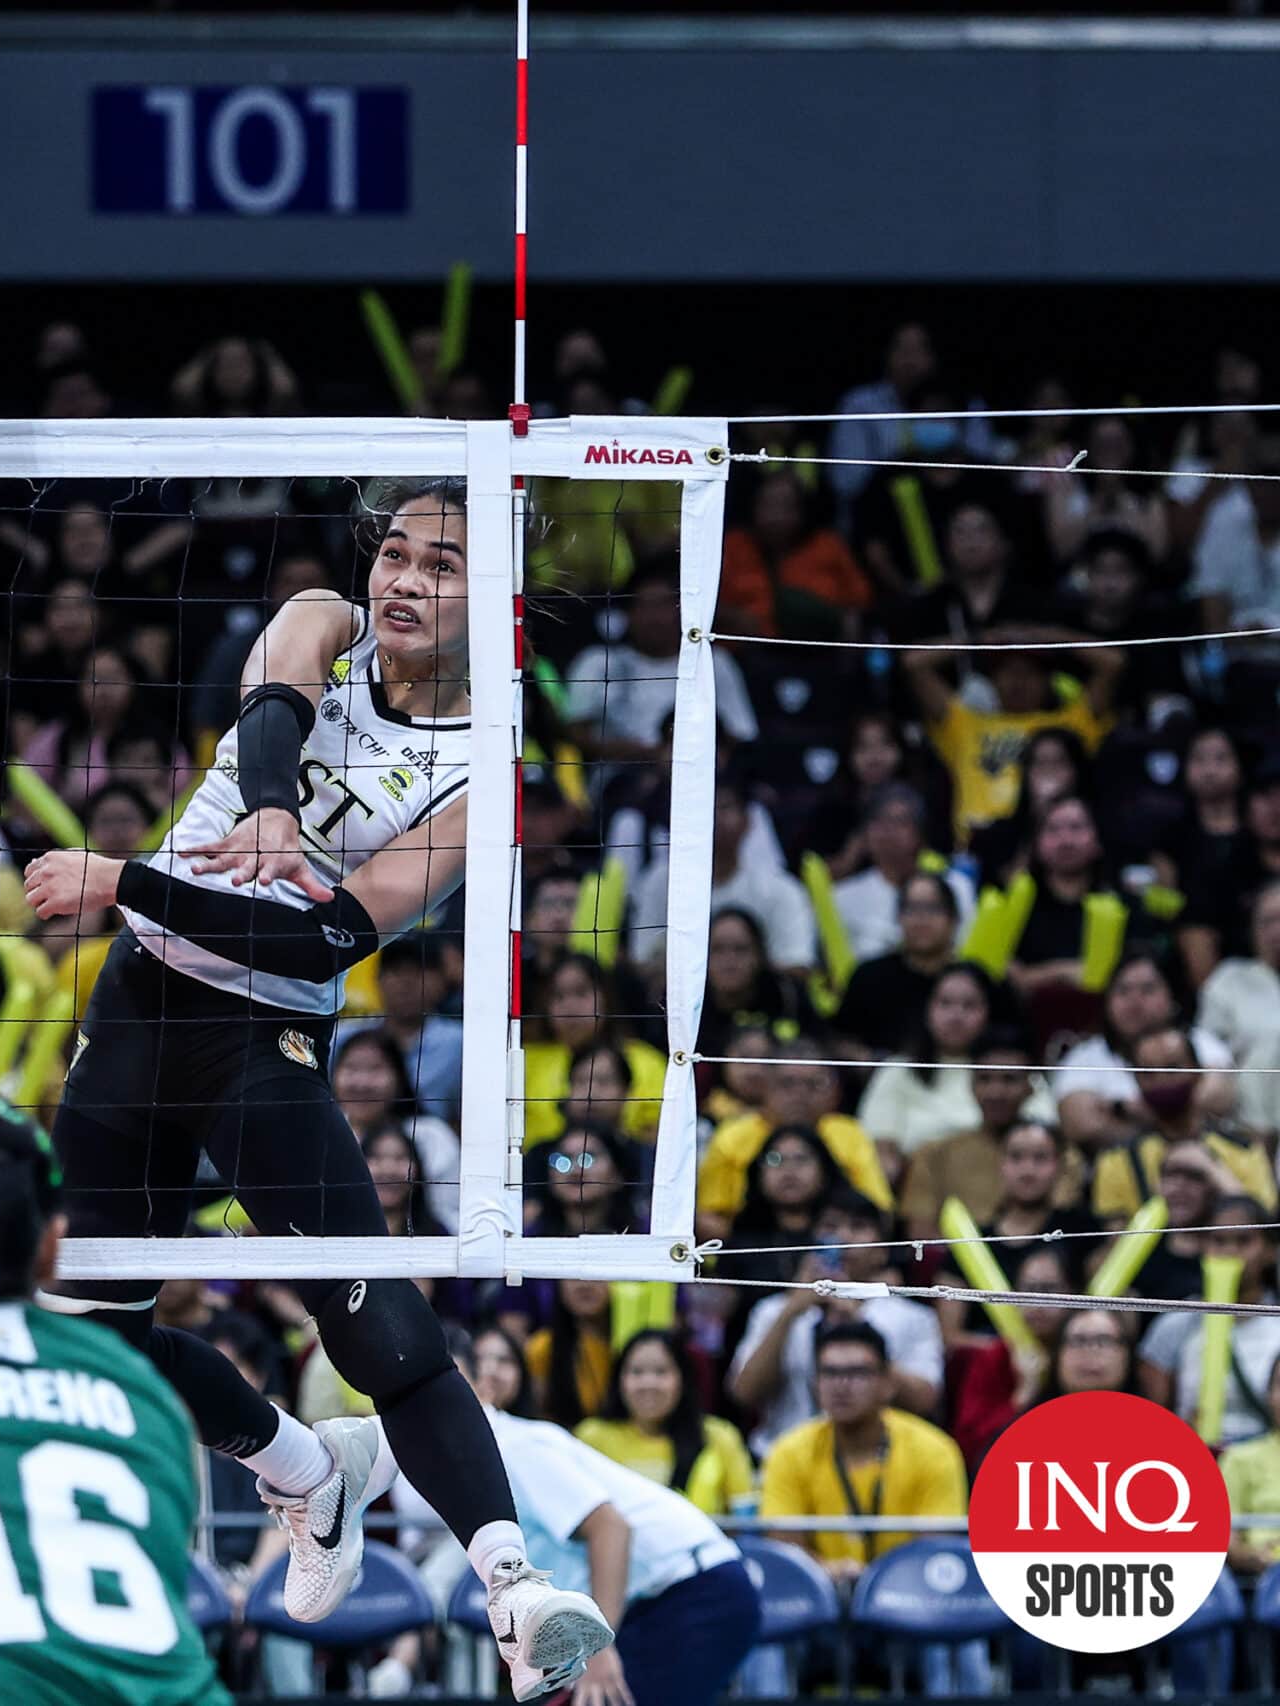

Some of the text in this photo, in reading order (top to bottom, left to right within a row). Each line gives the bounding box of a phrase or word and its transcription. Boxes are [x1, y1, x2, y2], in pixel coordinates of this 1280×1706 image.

[144, 86, 357, 214] 101
[584, 440, 693, 465] MIKASA
[358, 732, 388, 757] CHI
